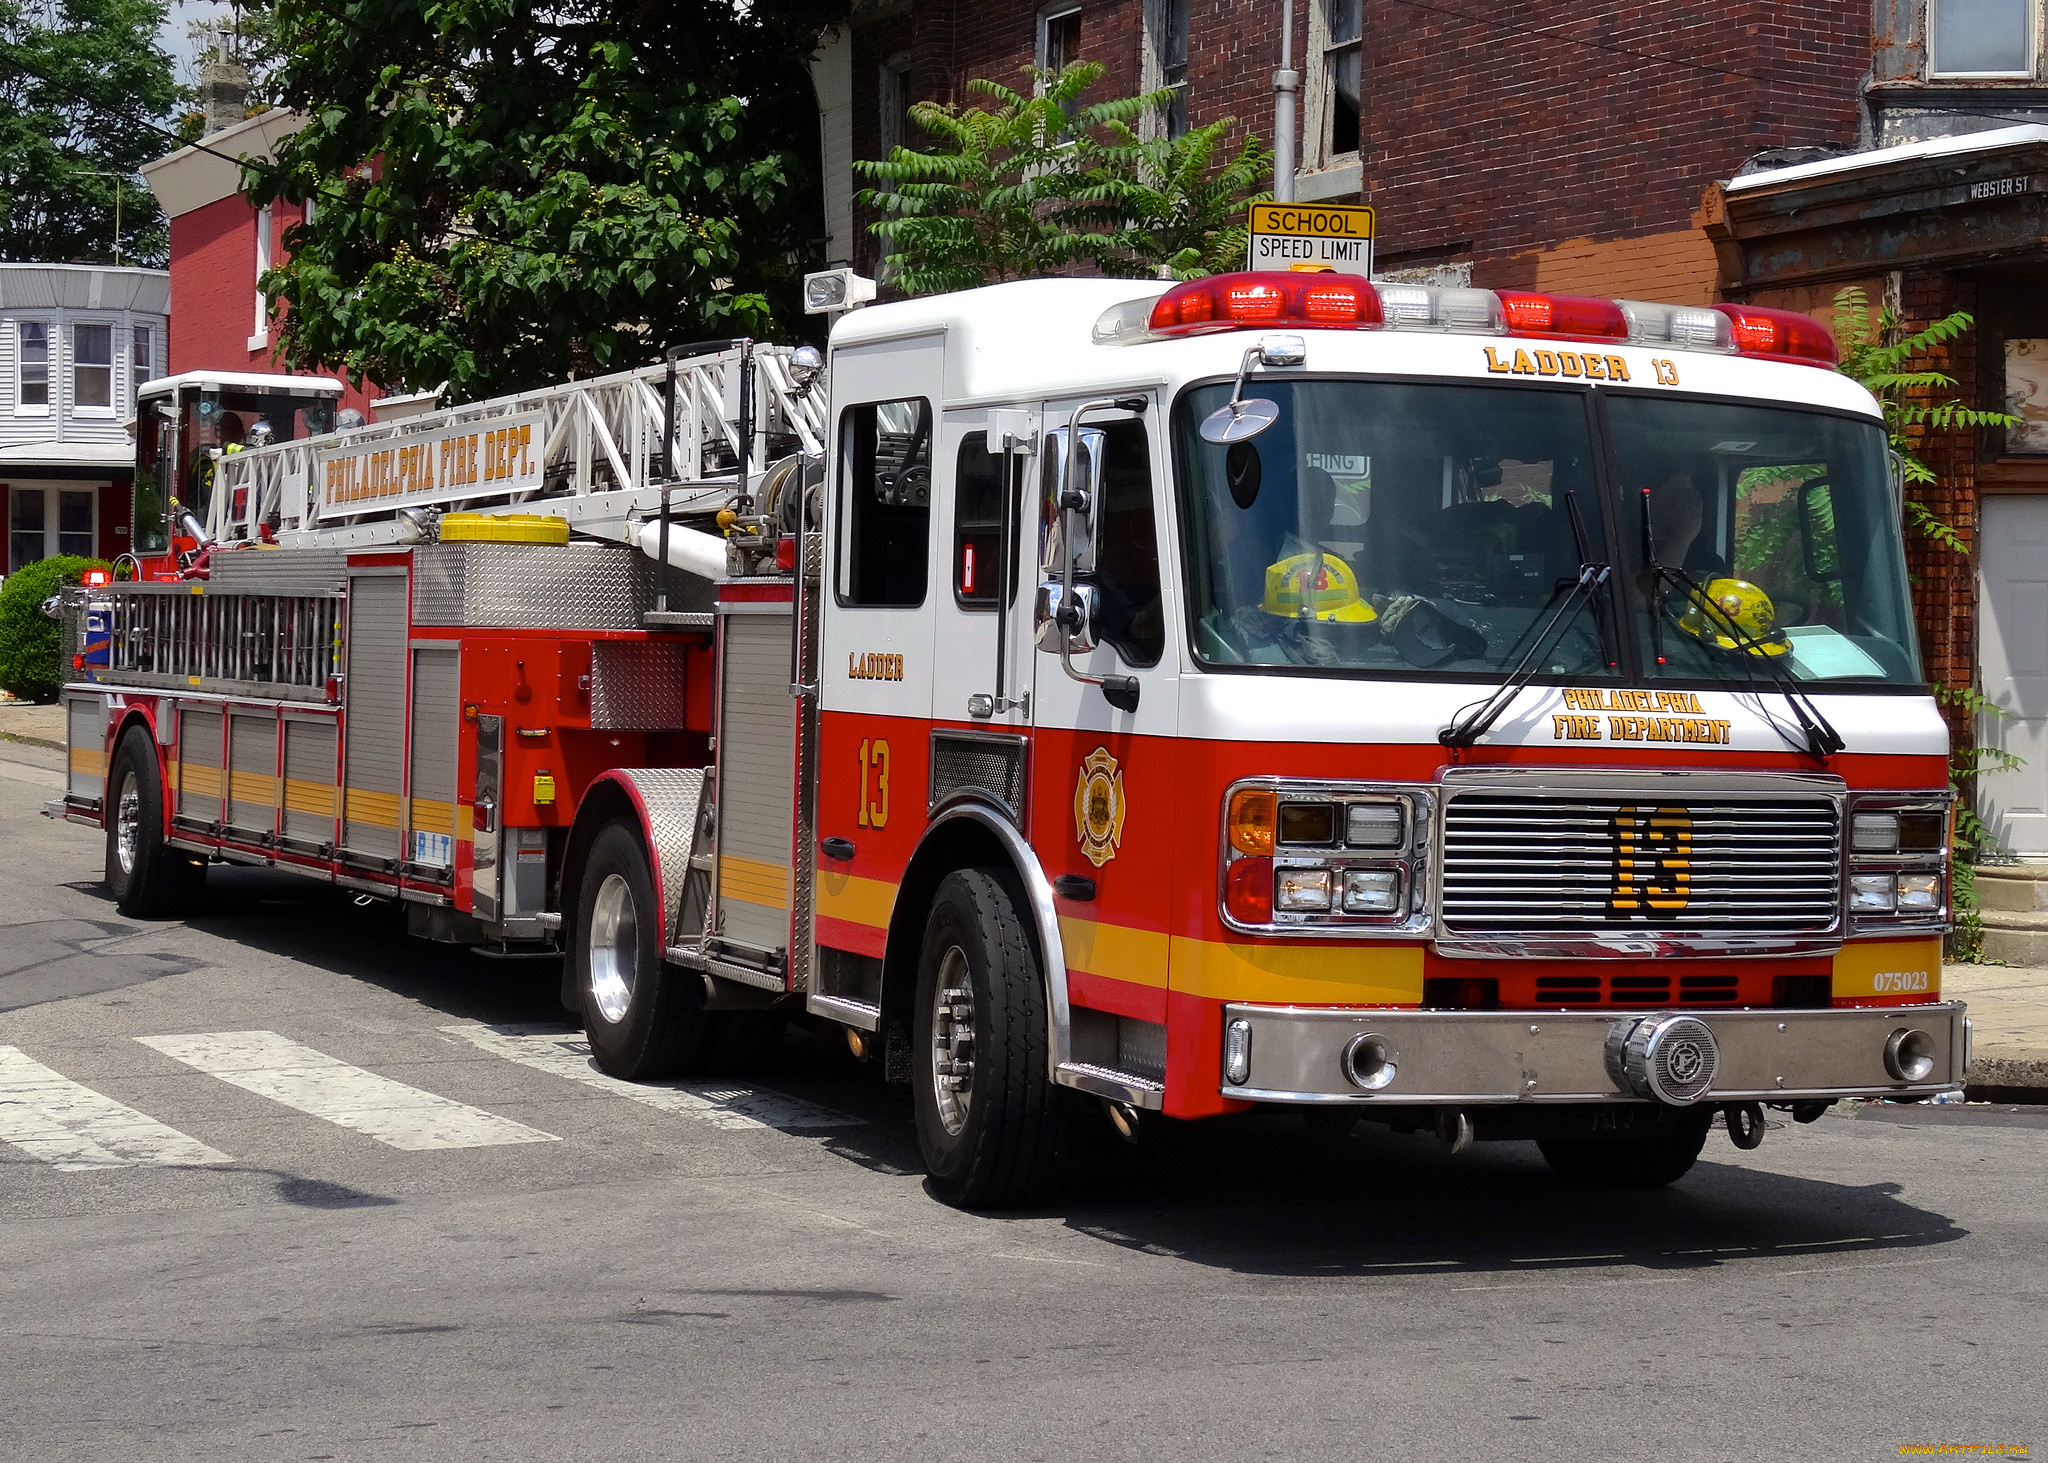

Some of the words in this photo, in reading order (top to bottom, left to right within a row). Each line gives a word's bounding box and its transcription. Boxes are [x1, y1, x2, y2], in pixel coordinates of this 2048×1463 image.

[1970, 178, 2013, 200] WEBSTER
[2015, 175, 2029, 193] ST
[1266, 211, 1357, 234] SCHOOL
[1259, 237, 1313, 259] SPEED
[1321, 240, 1362, 261] LIMIT
[1483, 346, 1631, 382] LADDER
[1652, 358, 1680, 386] 13
[326, 442, 434, 504] PHILADELPHIA
[439, 433, 478, 488] FIRE
[484, 424, 535, 481] DEPT.
[1306, 453, 1354, 470] HING
[849, 652, 904, 681] LADDER
[1562, 689, 1706, 714] PHILADELPHIA
[1552, 715, 1602, 740] FIRE
[1608, 716, 1731, 744] DEPARTMENT
[858, 738, 890, 830] 13
[1608, 804, 1693, 915] 13
[1873, 971, 1928, 992] 075023
